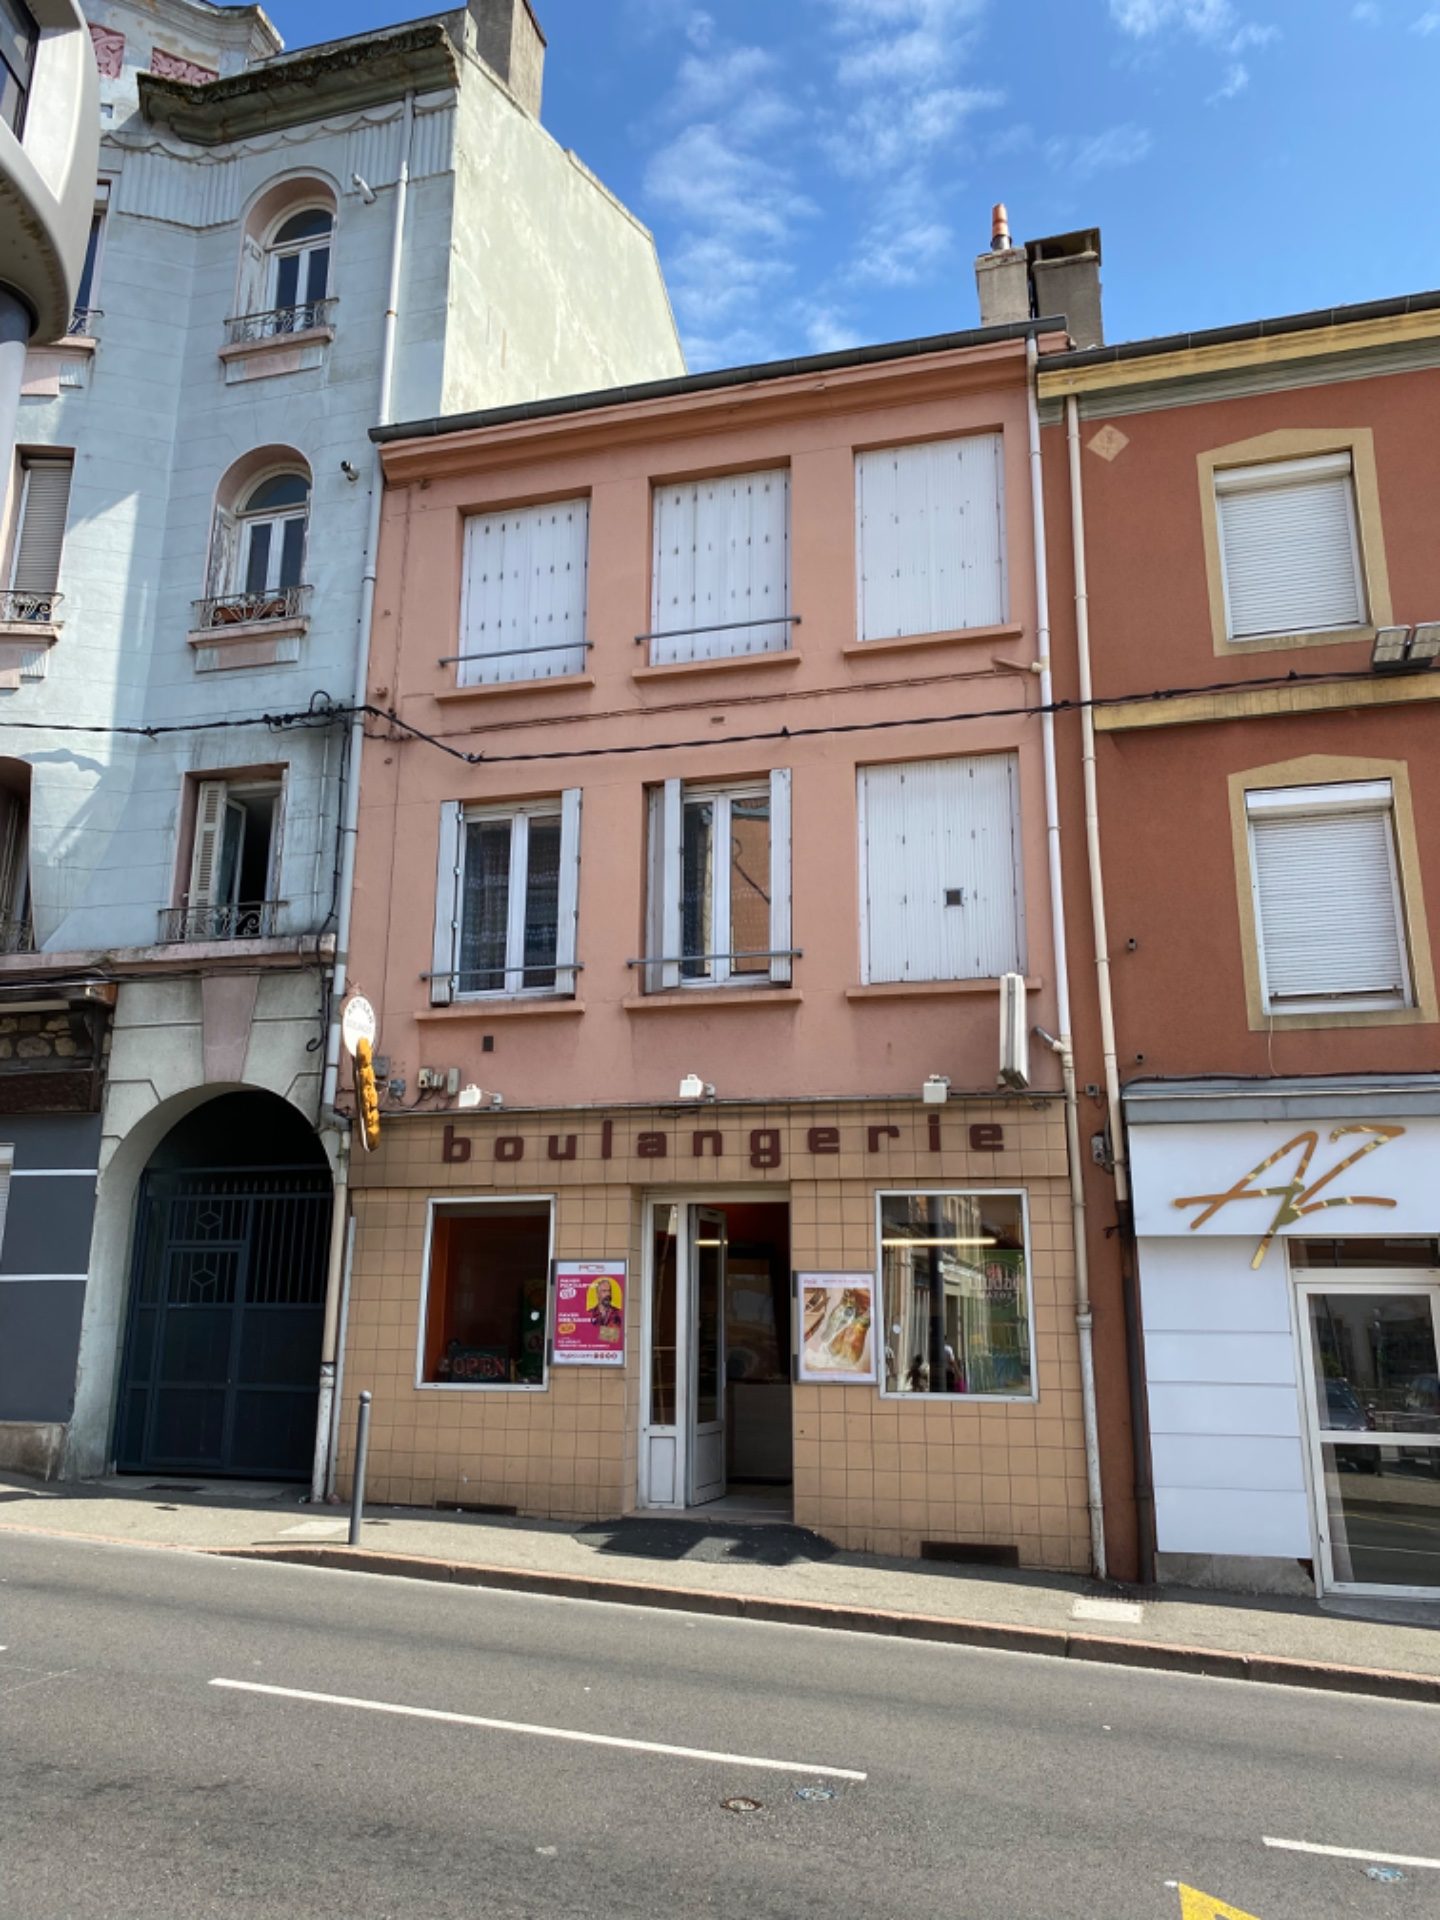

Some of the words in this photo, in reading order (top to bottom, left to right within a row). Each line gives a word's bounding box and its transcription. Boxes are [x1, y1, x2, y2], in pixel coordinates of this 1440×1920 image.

[442, 1114, 1004, 1168] boulangerie
[1173, 1124, 1406, 1270] AZ
[453, 1357, 505, 1377] OPEN
